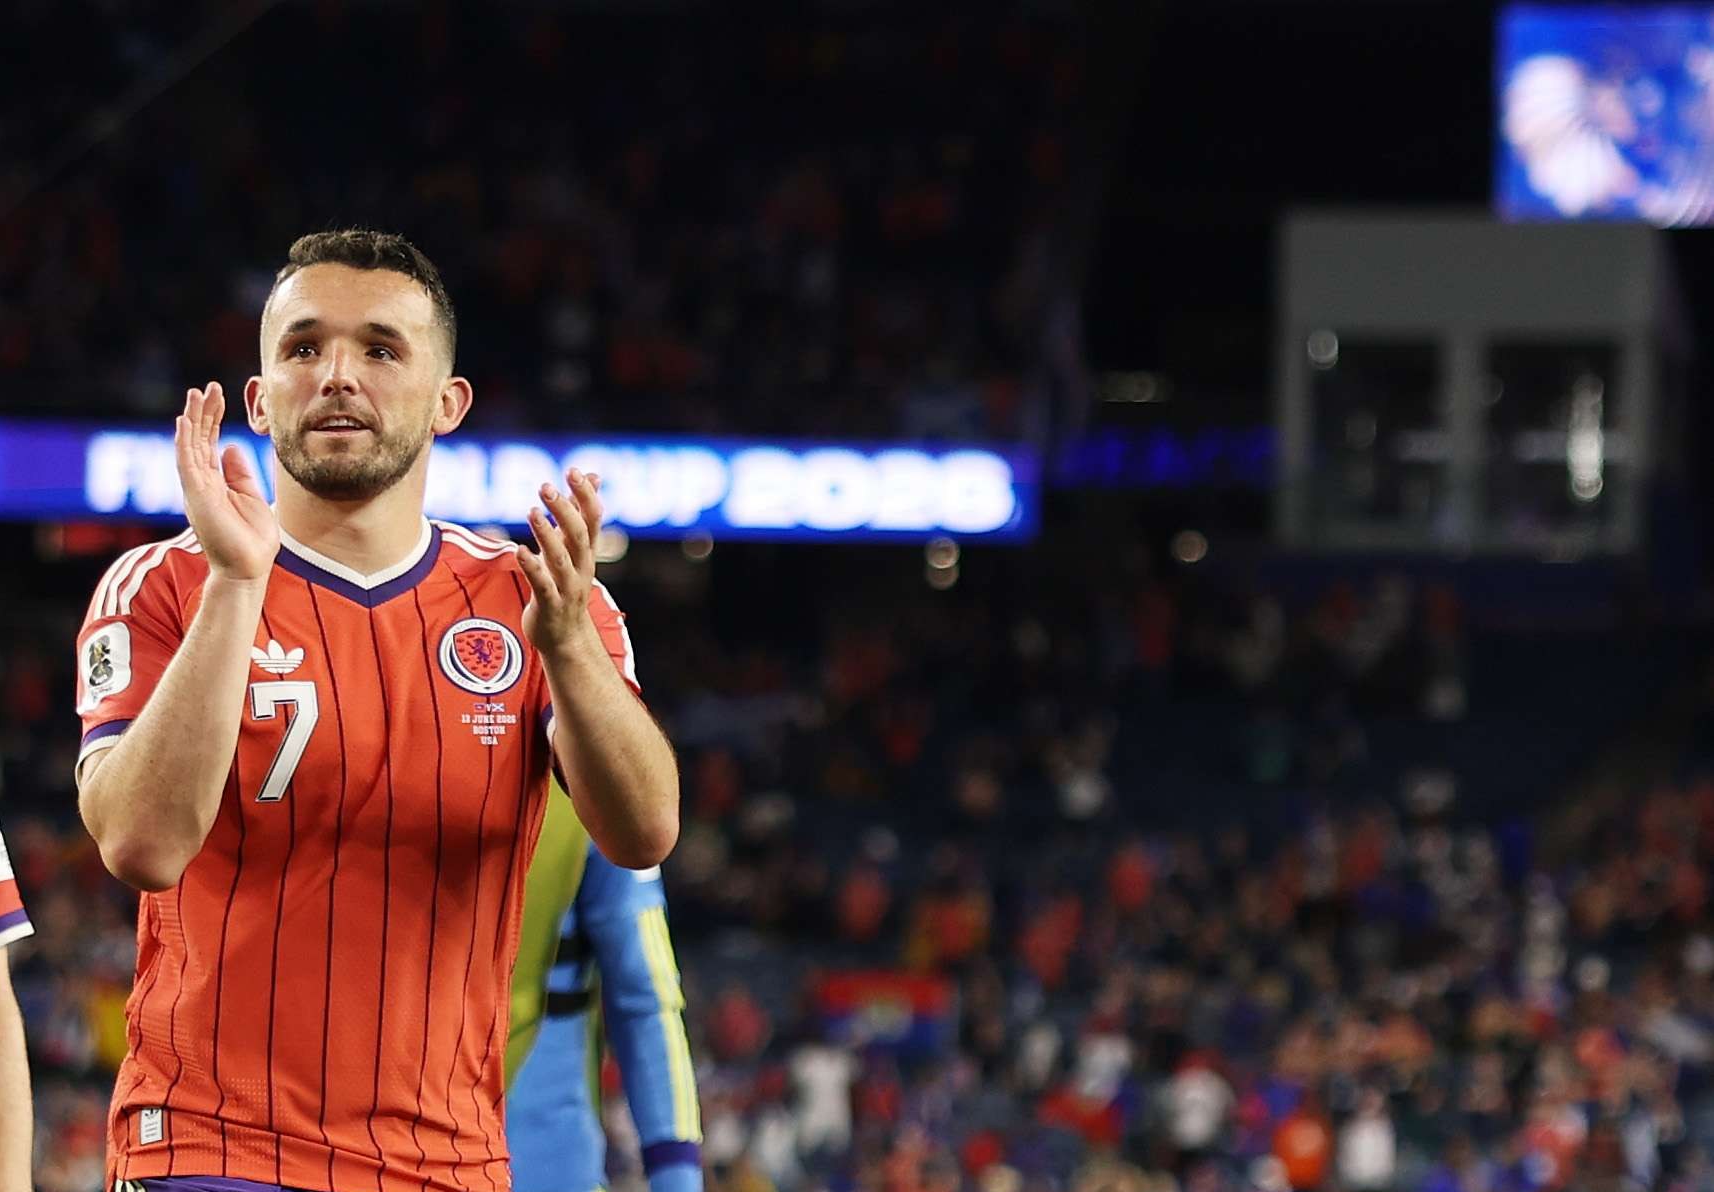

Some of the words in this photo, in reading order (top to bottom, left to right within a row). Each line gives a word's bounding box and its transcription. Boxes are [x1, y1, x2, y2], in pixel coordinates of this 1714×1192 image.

[560, 444, 727, 527] CUP
[722, 446, 1016, 534] 2026
[472, 714, 495, 724] JUNE
[472, 725, 506, 735] BOSTON
[250, 681, 319, 803] 7
[480, 735, 499, 745] USA
